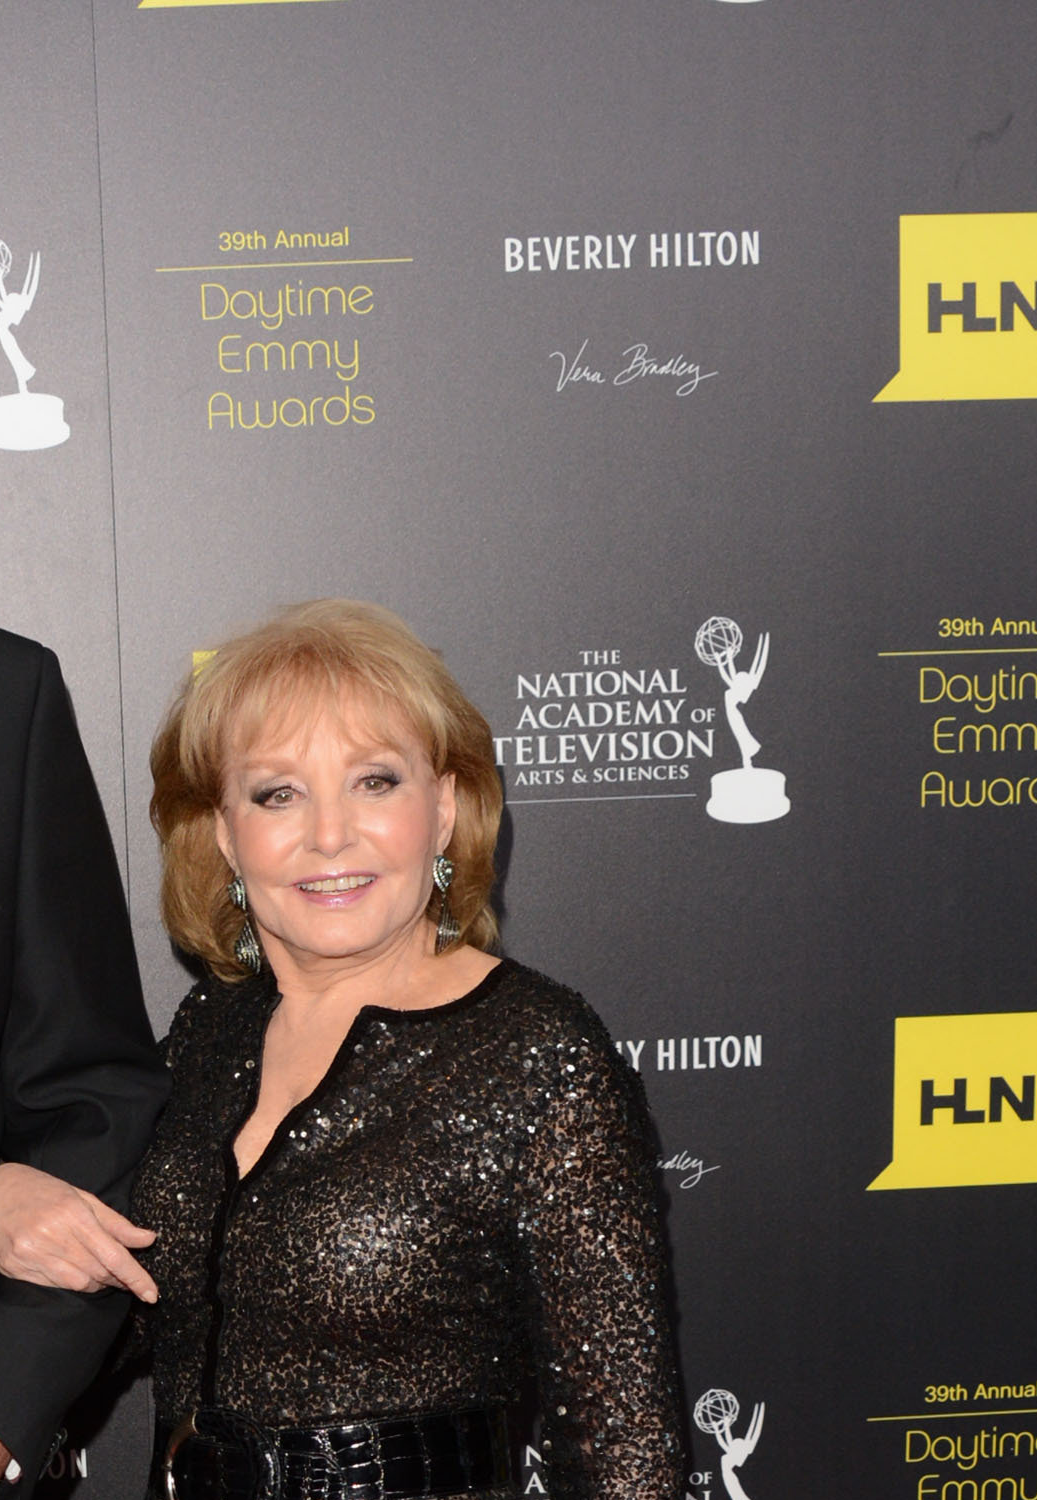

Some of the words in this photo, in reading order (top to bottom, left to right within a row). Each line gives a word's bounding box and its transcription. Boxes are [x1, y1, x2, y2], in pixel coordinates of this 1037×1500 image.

[219, 230, 266, 251] 39th
[274, 226, 349, 249] Annual
[504, 234, 637, 273] BEVERLY
[649, 230, 761, 268] HILTON
[201, 279, 374, 330] Daytime
[927, 280, 1037, 334] HLN
[218, 333, 359, 381] Emmy
[549, 339, 605, 392] Vera
[613, 343, 719, 396] Bradley
[208, 385, 375, 430] Awards
[938, 617, 984, 638] 39th
[579, 650, 621, 665] THE
[517, 668, 687, 699] NATIONAL
[516, 698, 687, 730] ACADEMY
[691, 708, 716, 724] OF
[492, 729, 715, 767] TELEVISION
[514, 769, 565, 786] ARTS
[571, 768, 588, 784] &
[593, 763, 689, 783] SCIENCES
[657, 1035, 762, 1071] HILTON
[920, 1075, 1037, 1126] HLN
[924, 1384, 968, 1403] 39th
[974, 1383, 1037, 1400] Annua
[905, 1426, 1037, 1470] Daytim
[689, 1472, 713, 1485] OF
